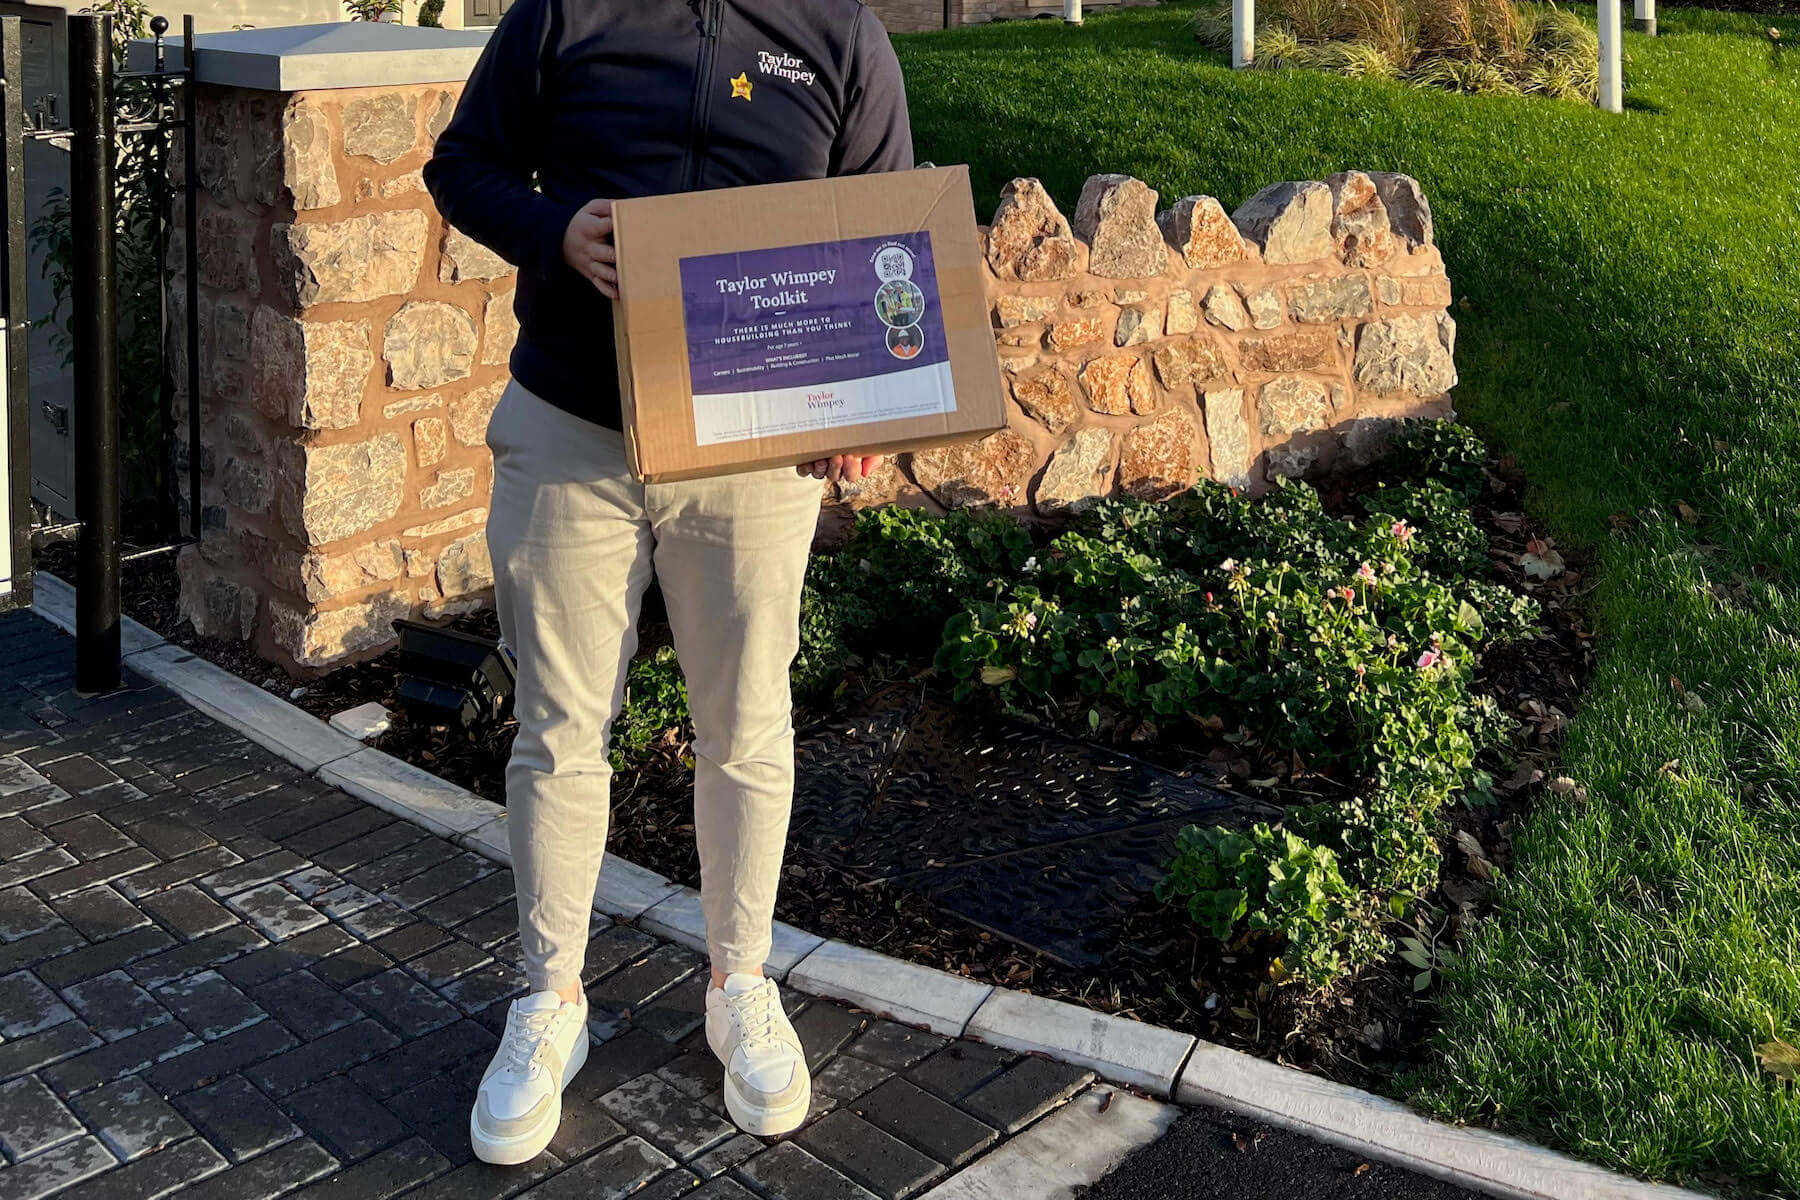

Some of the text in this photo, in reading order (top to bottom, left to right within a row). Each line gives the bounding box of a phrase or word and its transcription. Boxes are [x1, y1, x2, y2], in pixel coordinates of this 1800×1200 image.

[758, 50, 803, 69] Taylor
[758, 61, 816, 86] Wimpey
[716, 269, 837, 295] Taylor Wimpey
[750, 290, 809, 310] Toolkit
[714, 330, 780, 345] HOUSEBUILDING
[782, 327, 804, 336] THAN
[734, 326, 758, 335] THERE
[771, 322, 794, 330] MUCH
[796, 318, 818, 327] MORE
